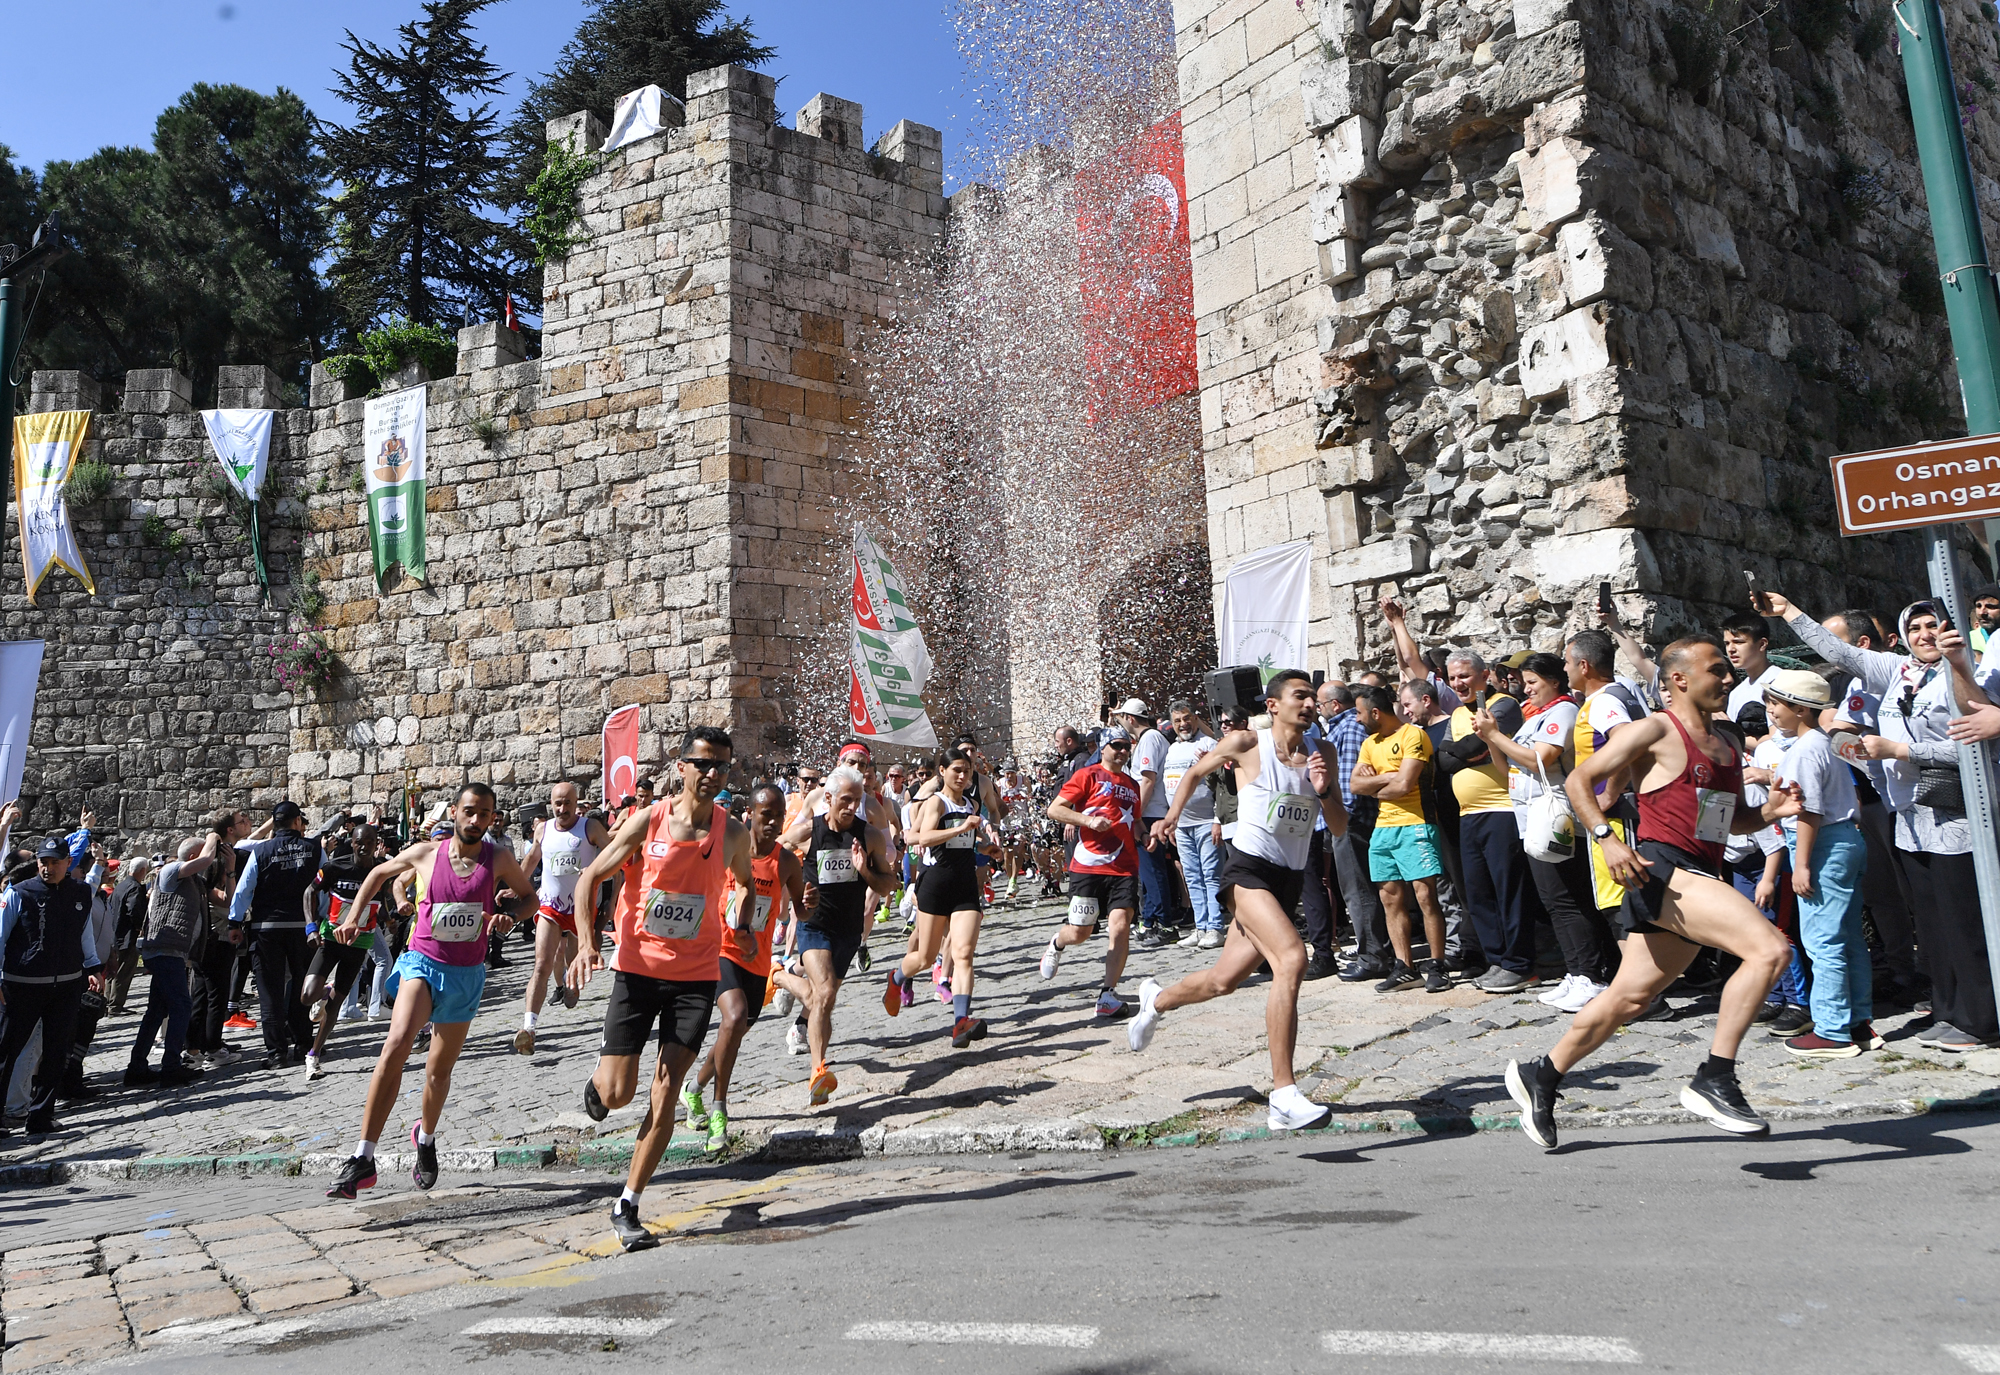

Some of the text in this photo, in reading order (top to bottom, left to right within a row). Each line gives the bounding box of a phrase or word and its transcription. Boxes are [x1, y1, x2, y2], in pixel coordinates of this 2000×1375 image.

[34, 509, 60, 520] KENT
[856, 549, 885, 624] BURSASPOR
[875, 651, 909, 704] 1963
[851, 653, 881, 728] BURSASPOR
[1277, 805, 1309, 822] 0103
[1720, 807, 1726, 823] 1
[555, 857, 577, 866] 1240
[824, 859, 852, 871] 0262
[654, 903, 694, 922] 0924
[1072, 904, 1095, 915] 0303
[441, 914, 475, 928] 1005
